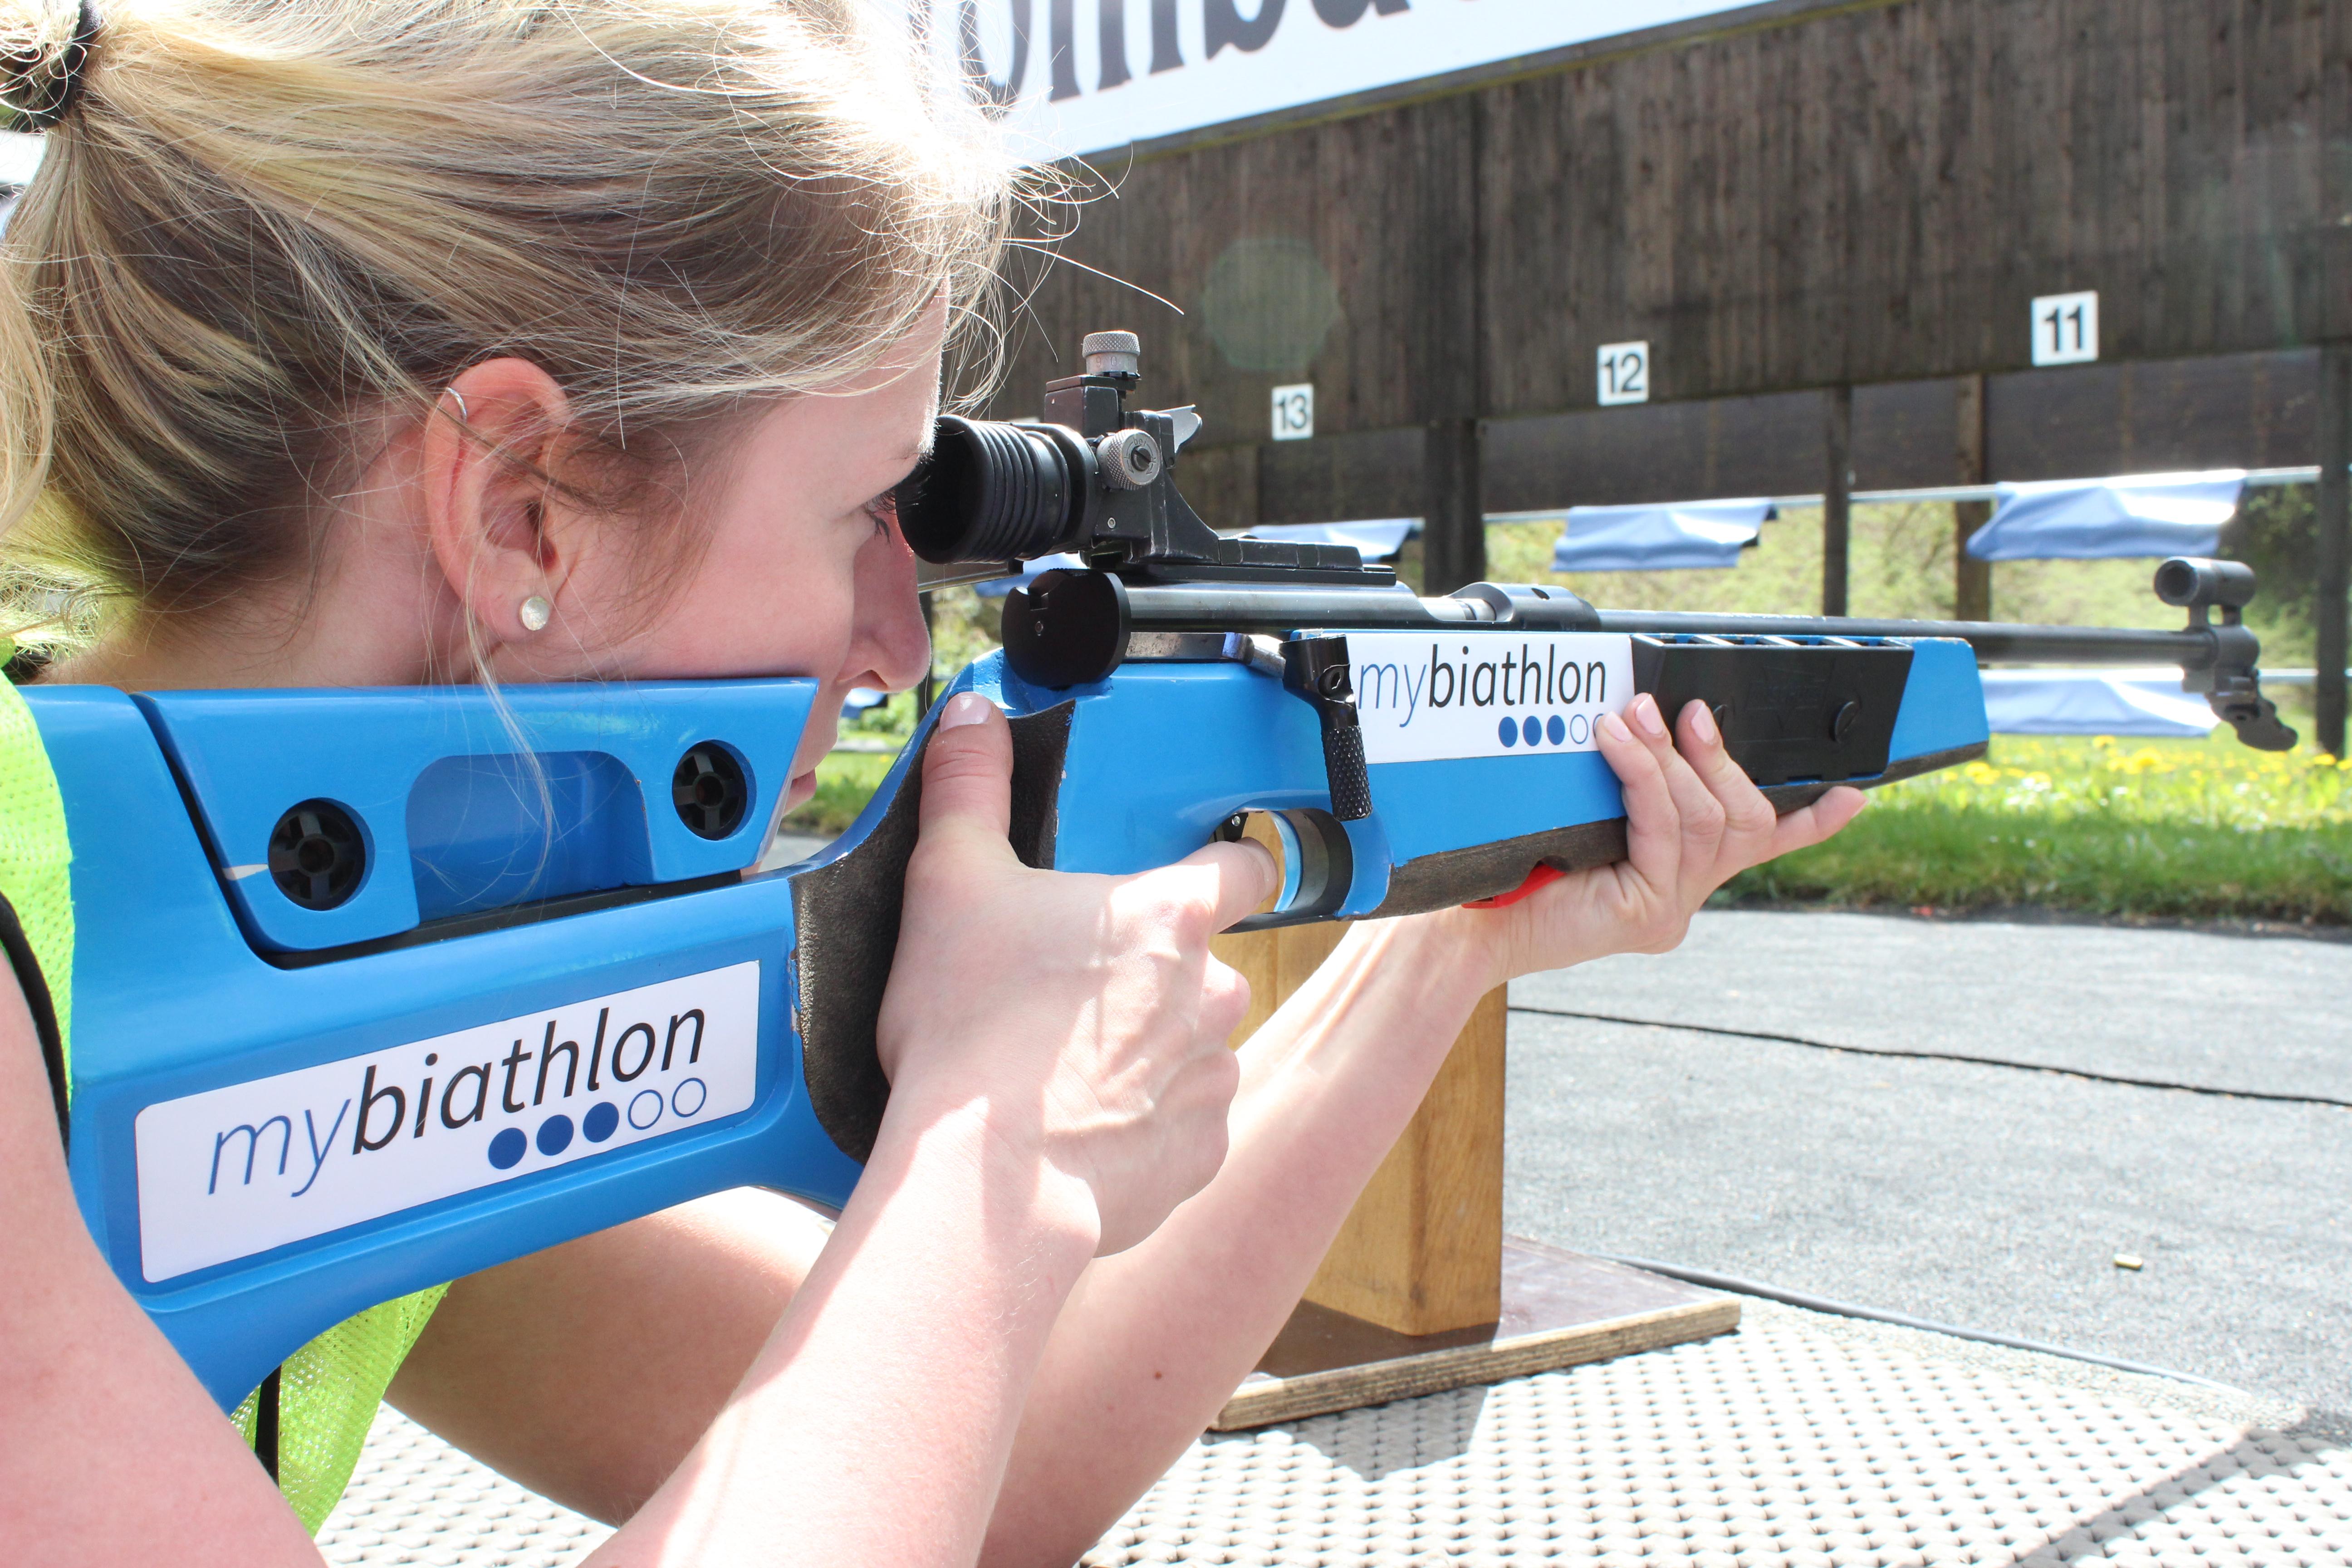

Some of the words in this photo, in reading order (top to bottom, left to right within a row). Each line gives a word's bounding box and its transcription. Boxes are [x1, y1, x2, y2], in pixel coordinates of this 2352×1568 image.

[2044, 306, 2082, 352] 11
[1602, 353, 1642, 394] 12
[1277, 394, 1307, 429] 13
[1358, 643, 1606, 727] mybiathlon
[207, 1006, 706, 1198] mybiathlon
